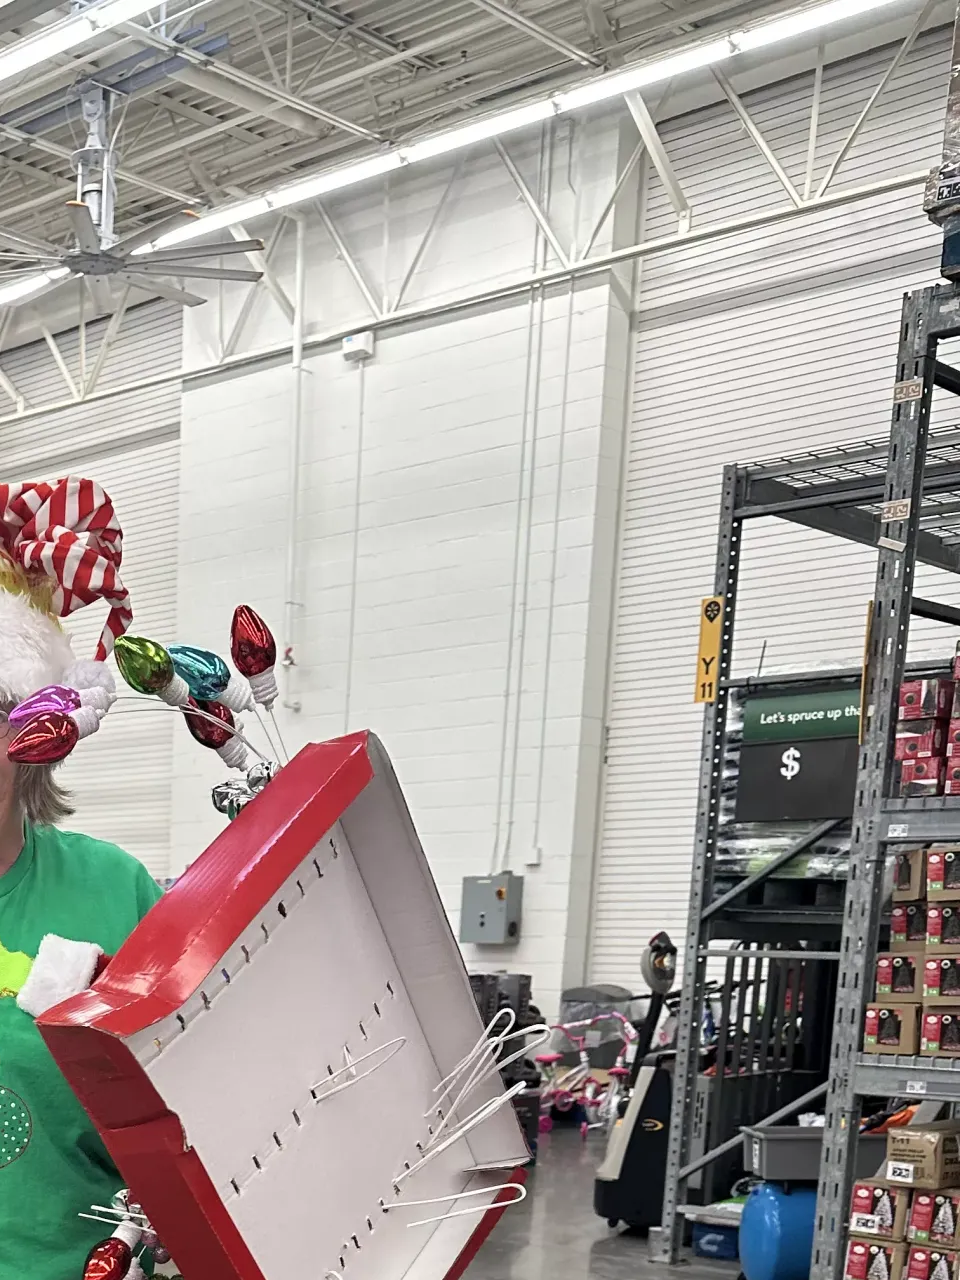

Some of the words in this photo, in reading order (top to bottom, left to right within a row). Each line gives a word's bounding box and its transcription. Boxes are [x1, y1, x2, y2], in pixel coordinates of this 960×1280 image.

[701, 656, 715, 675] Y
[700, 682, 713, 698] 11
[760, 712, 785, 725] Let's
[787, 711, 825, 725] spruce
[827, 709, 842, 721] up
[780, 747, 801, 780] $
